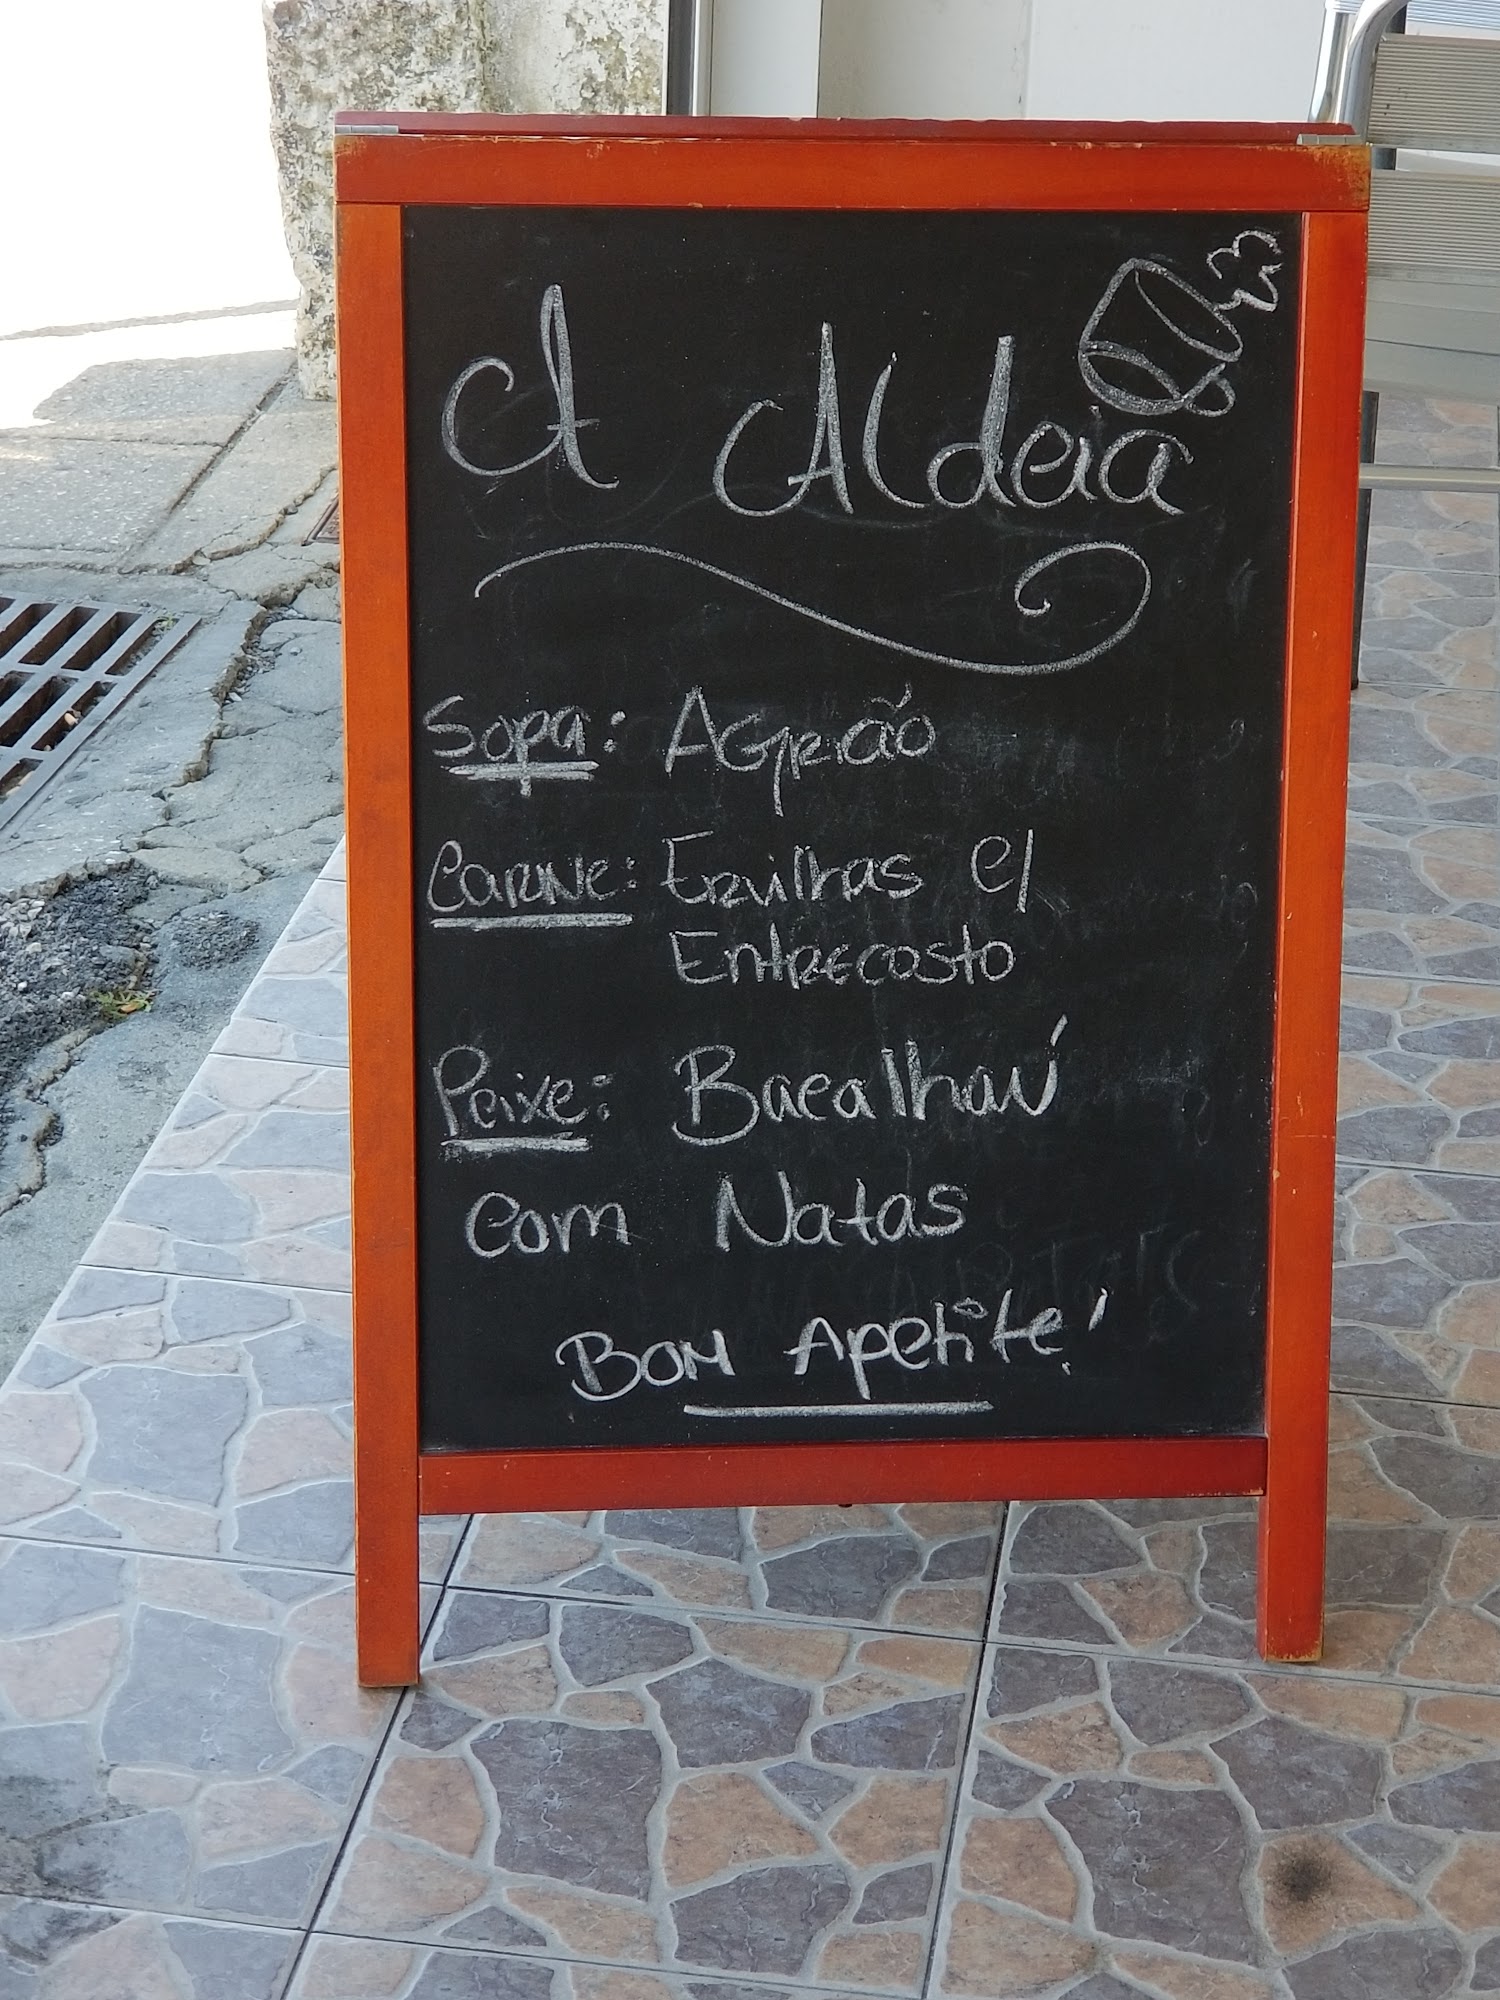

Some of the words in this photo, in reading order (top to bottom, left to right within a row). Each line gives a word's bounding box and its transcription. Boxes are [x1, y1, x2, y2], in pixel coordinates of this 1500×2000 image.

[422, 695, 626, 797] Sopa:
[660, 829, 925, 908] Ervilhas
[668, 922, 1017, 990] Entrecosto
[432, 1044, 617, 1138] Peixe:
[714, 1170, 969, 1251] Natas
